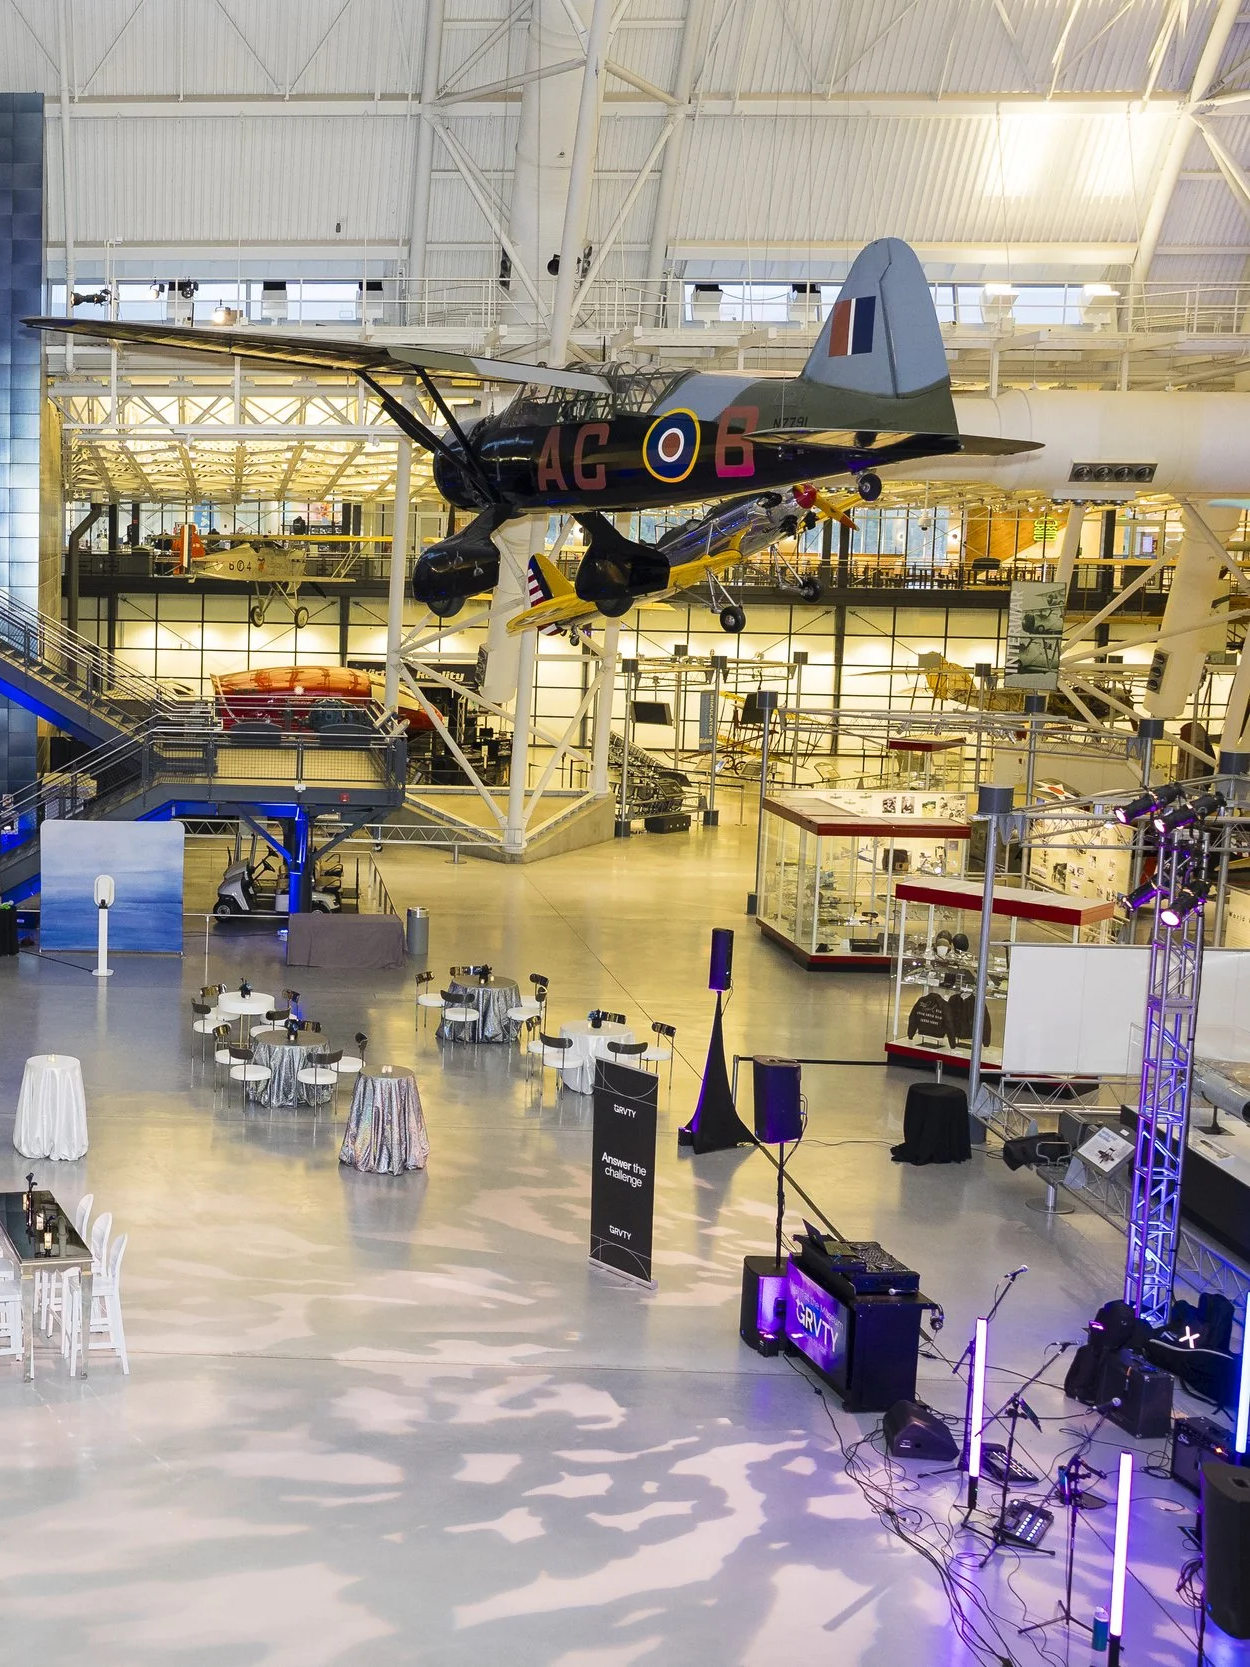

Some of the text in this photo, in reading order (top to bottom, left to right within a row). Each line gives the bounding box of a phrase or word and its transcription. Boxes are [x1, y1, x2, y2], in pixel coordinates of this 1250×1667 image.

[773, 416, 808, 428] N7791
[1006, 590, 1024, 673] INTERWAR
[613, 1104, 637, 1119] GRVTY
[601, 1152, 647, 1177] Answer the
[604, 1166, 643, 1188] challenge
[609, 1225, 632, 1241] GRVTY
[796, 1299, 839, 1353] GRVTY
